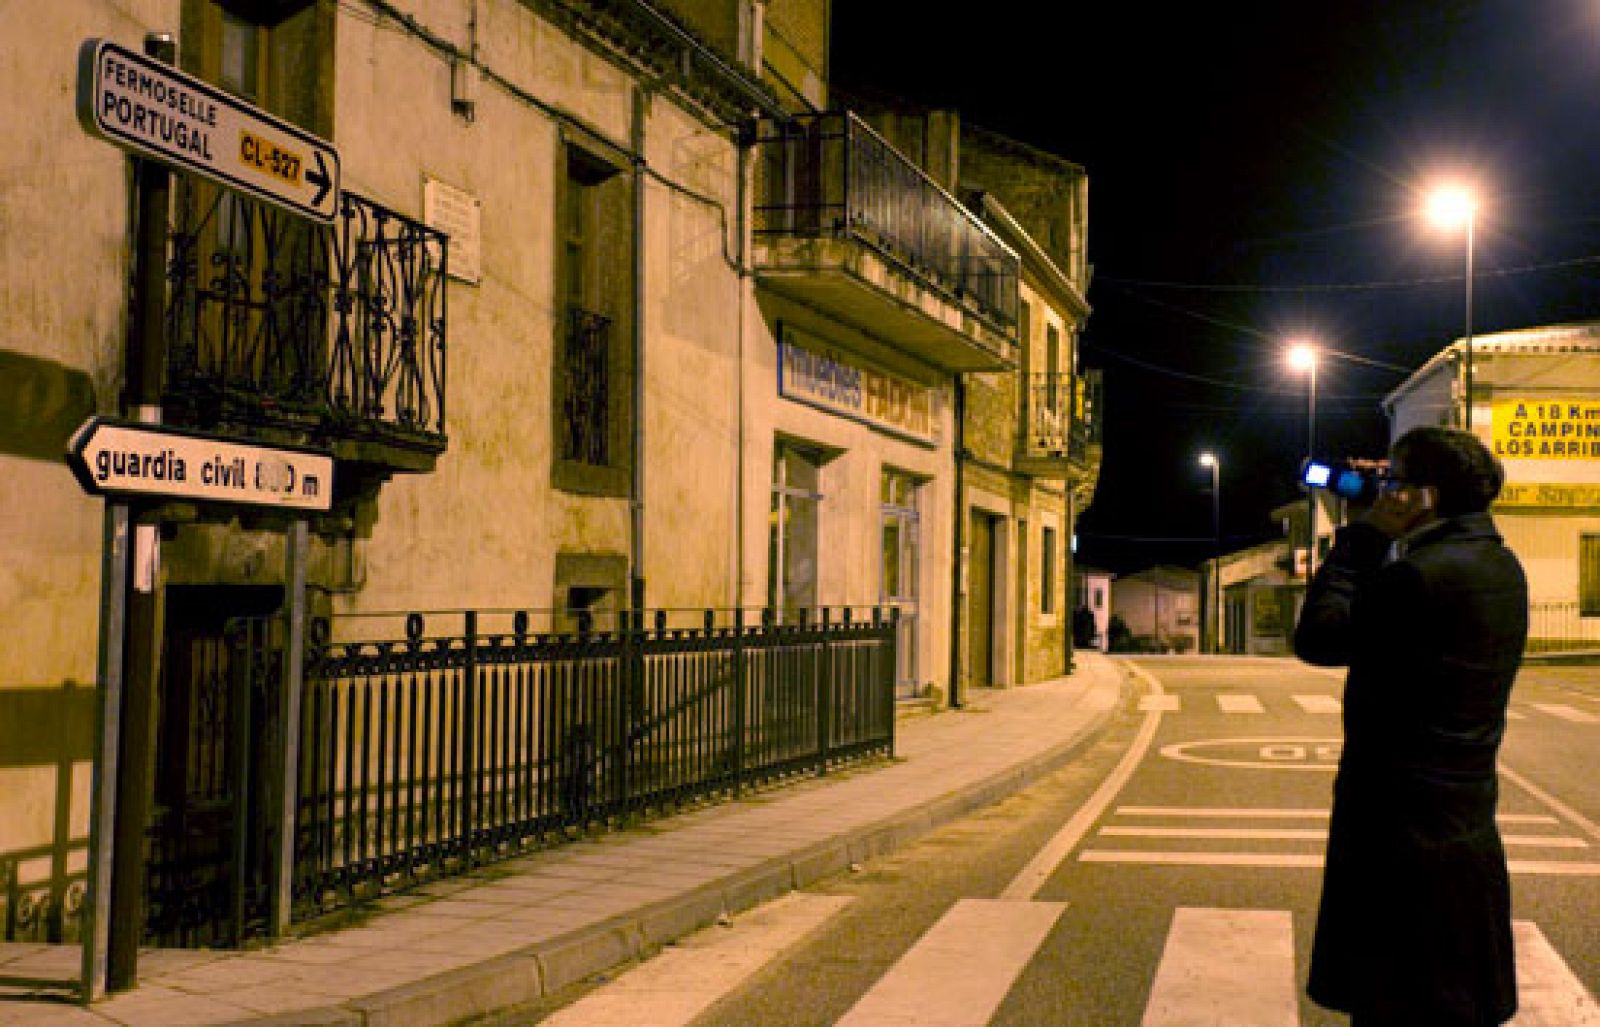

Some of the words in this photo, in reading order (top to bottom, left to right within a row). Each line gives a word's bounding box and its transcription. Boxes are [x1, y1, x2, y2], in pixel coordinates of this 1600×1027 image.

[104, 57, 217, 128] FERMOSELLE
[104, 89, 213, 161] PORTUGAL
[240, 135, 301, 181] CL-527
[1515, 403, 1528, 419] A
[1495, 439, 1534, 456] LOS
[96, 449, 187, 481] guardia
[200, 454, 246, 489] civil
[302, 473, 318, 496] m
